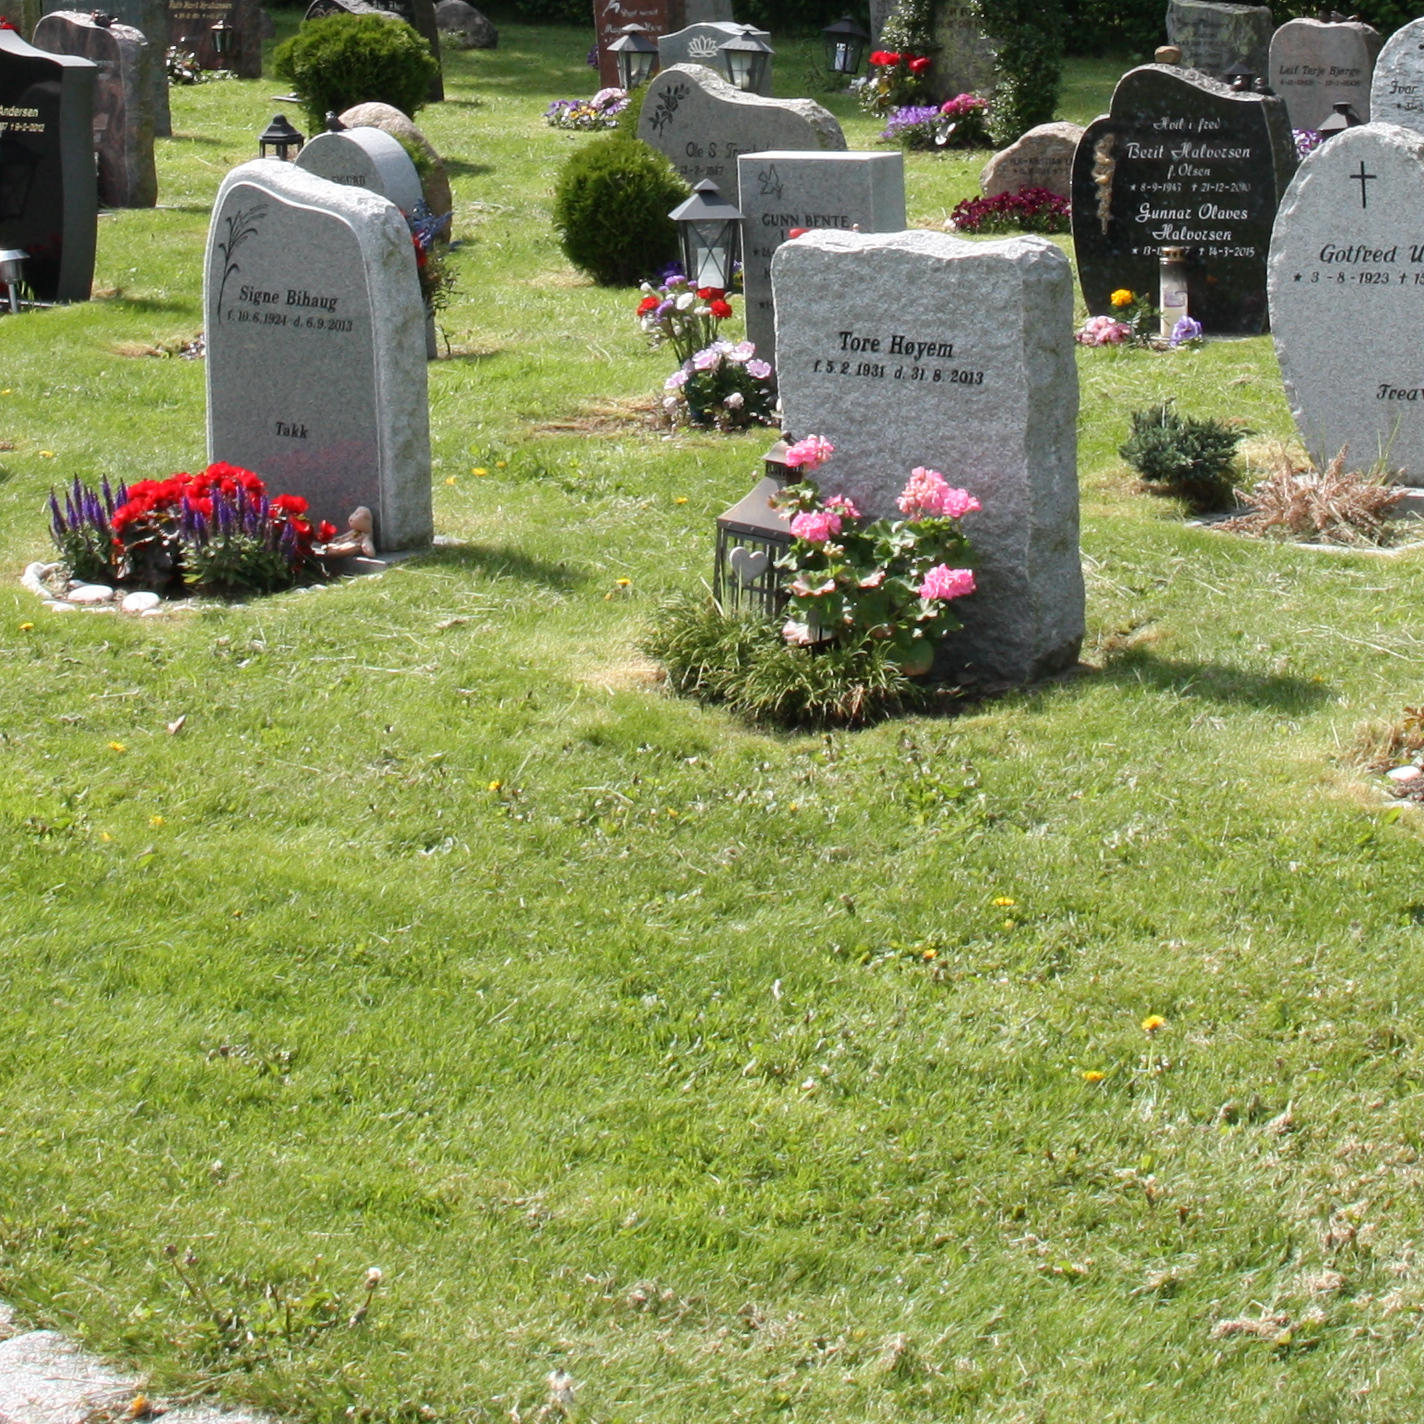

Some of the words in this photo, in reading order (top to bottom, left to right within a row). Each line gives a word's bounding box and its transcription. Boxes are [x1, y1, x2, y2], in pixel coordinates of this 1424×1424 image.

[1389, 80, 1418, 95] Ivar
[1126, 142, 1164, 159] Berit
[1170, 142, 1251, 159] Halvorsen
[1178, 163, 1211, 176] Olsen
[762, 214, 799, 226] GUNN
[805, 214, 850, 228] BENTE
[1135, 202, 1192, 222] Gunnar
[1198, 203, 1248, 219] Olaves
[1152, 223, 1232, 241] Halvorsen
[1320, 244, 1397, 264] Gotfred
[239, 285, 280, 306] Signe
[286, 289, 338, 313] Bihaug
[839, 331, 880, 352] Tore
[889, 335, 954, 362] Høyem
[277, 421, 308, 439] Takk
